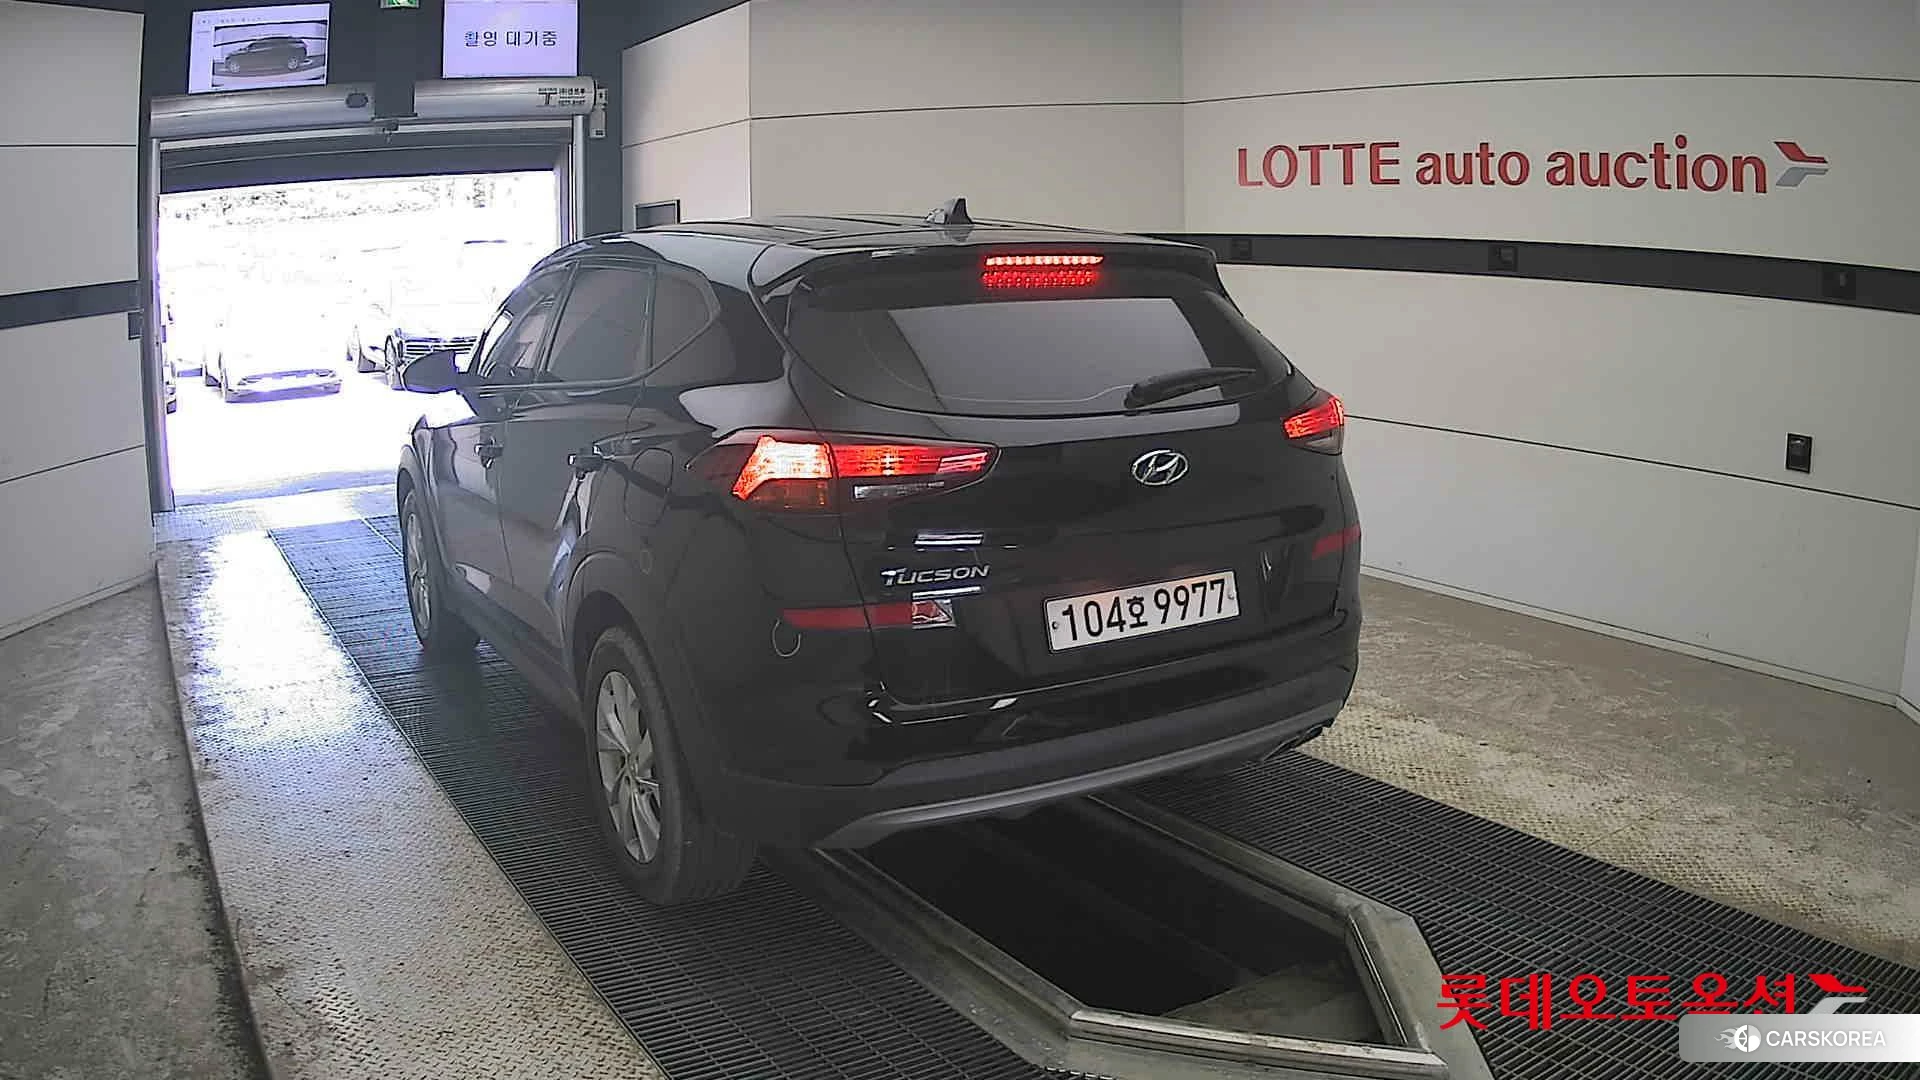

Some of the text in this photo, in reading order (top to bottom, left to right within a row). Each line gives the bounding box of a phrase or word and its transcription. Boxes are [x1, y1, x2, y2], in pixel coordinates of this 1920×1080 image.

[505, 30, 558, 48] 대기중
[1238, 135, 1767, 193] LOTTE auto auction
[880, 564, 990, 586] TUCSON
